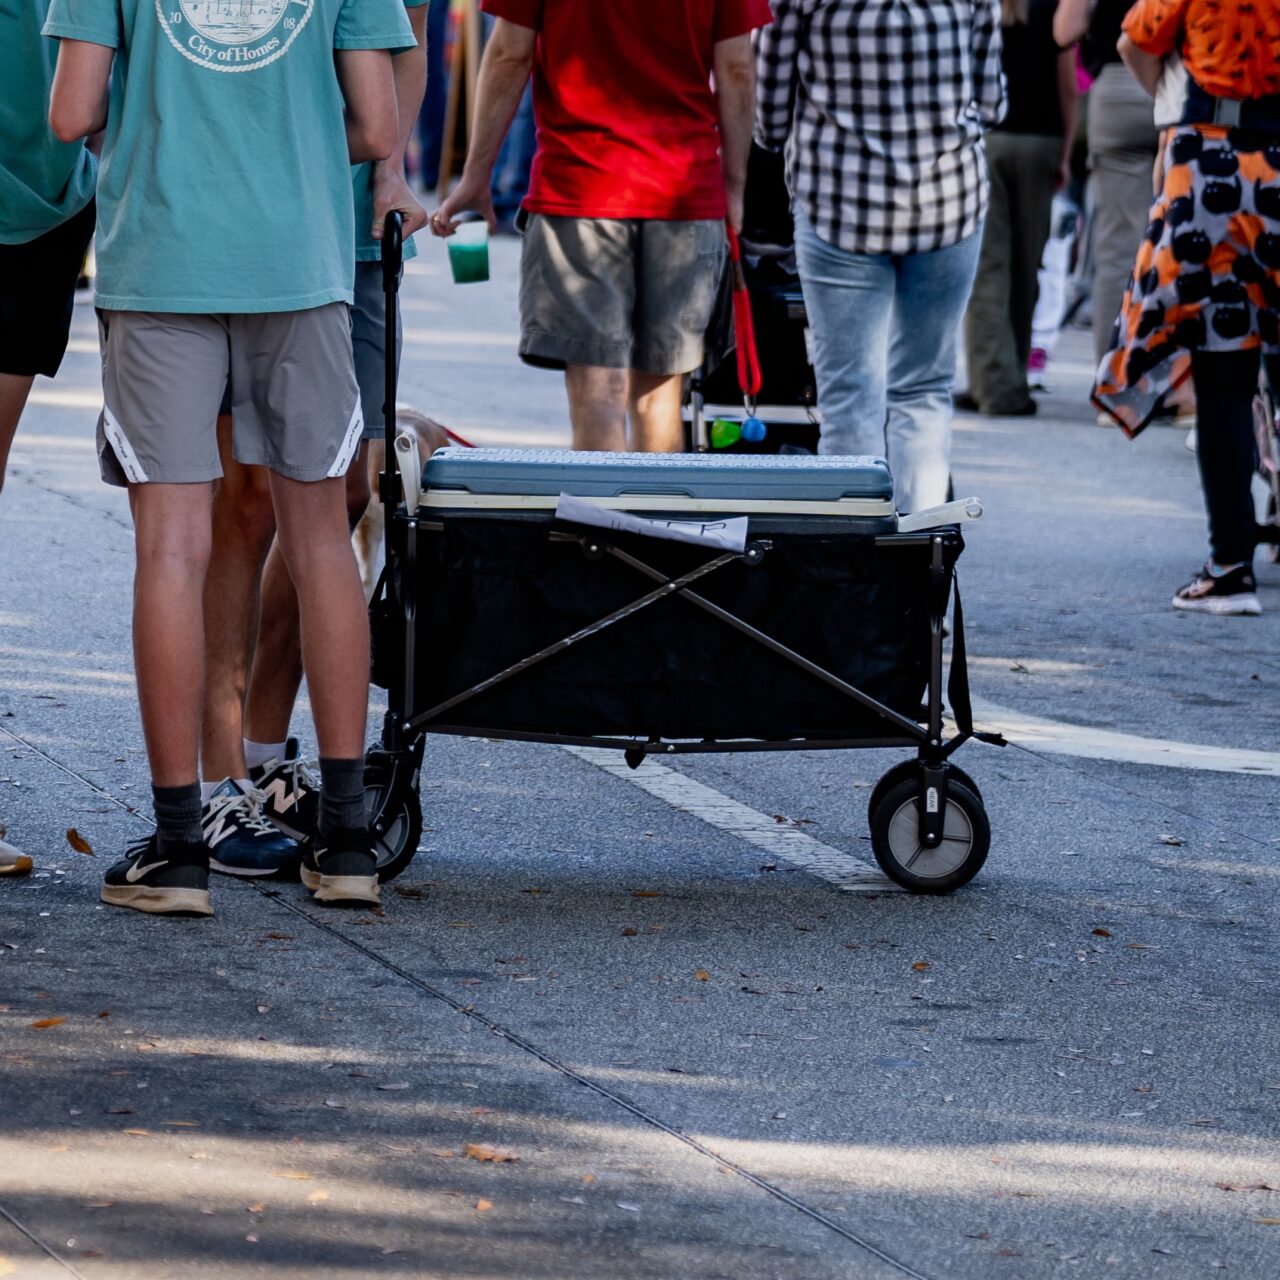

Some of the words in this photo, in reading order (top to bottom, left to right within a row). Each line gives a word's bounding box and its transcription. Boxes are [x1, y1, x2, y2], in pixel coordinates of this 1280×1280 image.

[170, 11, 182, 24] 20
[283, 17, 296, 30] 08
[188, 34, 217, 61] City
[217, 47, 234, 62] of
[234, 36, 280, 62] Homes
